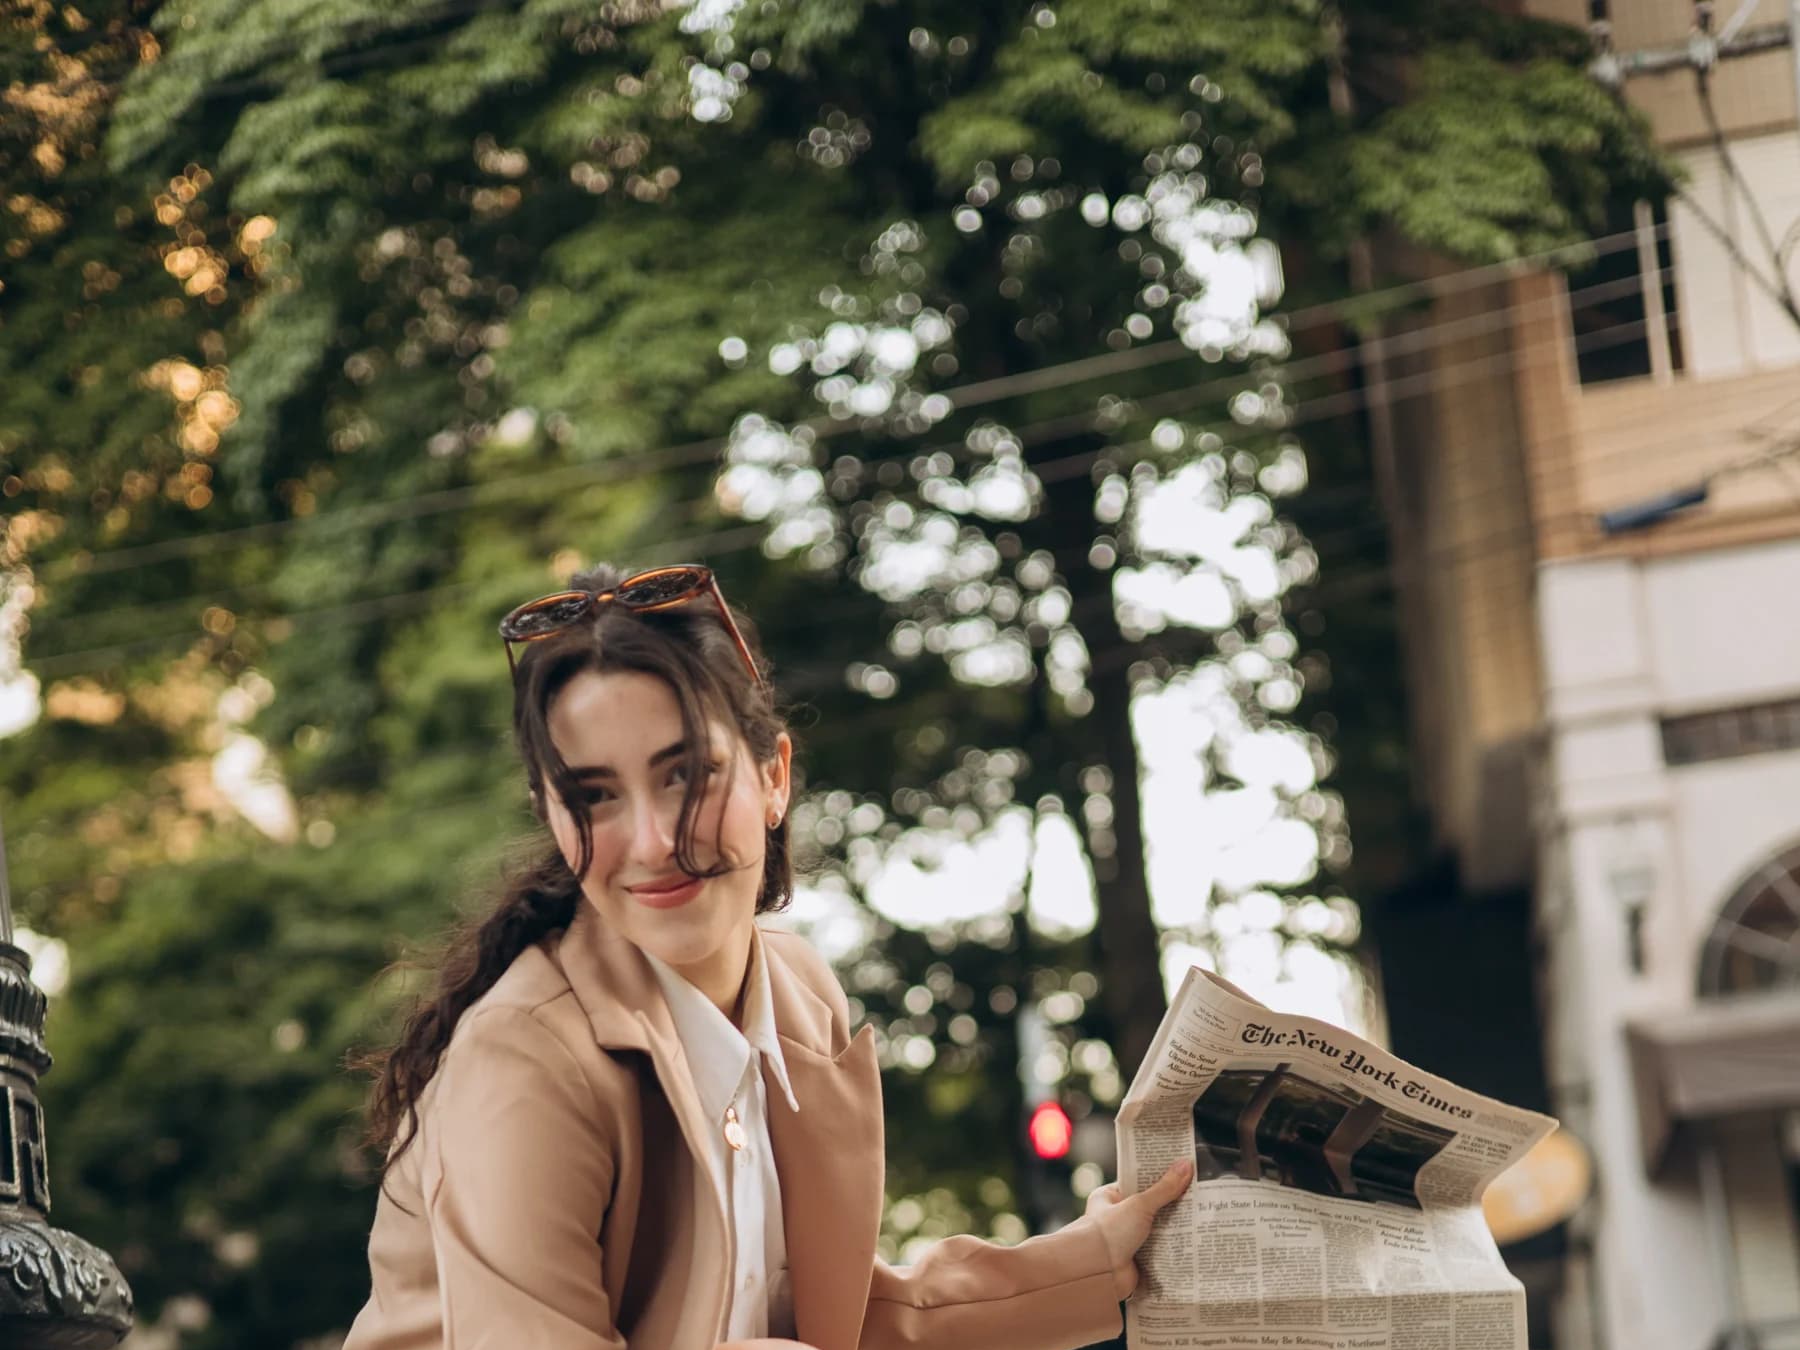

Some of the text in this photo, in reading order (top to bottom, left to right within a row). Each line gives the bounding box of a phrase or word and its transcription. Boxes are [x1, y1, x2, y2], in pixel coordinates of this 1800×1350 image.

[1241, 1023, 1287, 1047] The
[1287, 1029, 1341, 1057] New
[1340, 1050, 1400, 1089] York
[1402, 1081, 1473, 1119] Times
[1230, 1200, 1250, 1209] State
[1260, 1336, 1279, 1346] May
[1282, 1336, 1293, 1344] Be
[1295, 1336, 1334, 1349] Returning
[1336, 1340, 1346, 1349] to
